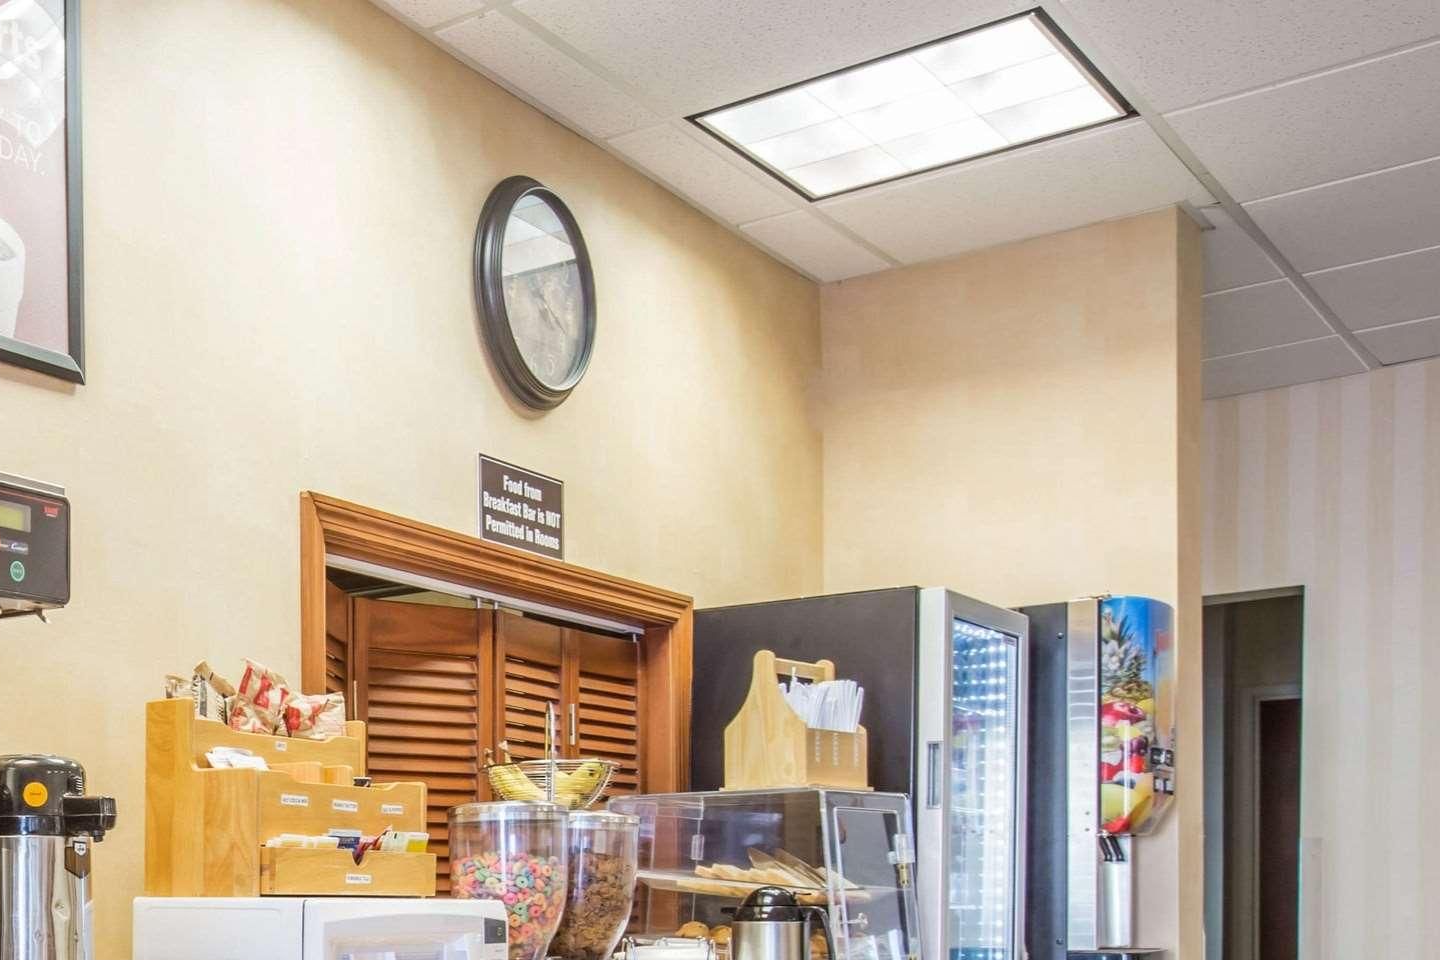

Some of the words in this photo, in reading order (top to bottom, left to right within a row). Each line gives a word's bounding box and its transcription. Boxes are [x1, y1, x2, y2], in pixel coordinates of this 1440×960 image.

[503, 475, 522, 496] Food
[524, 482, 542, 502] from
[484, 491, 522, 517] Breakfast
[523, 503, 536, 521] Bar
[538, 508, 544, 524] is
[546, 511, 560, 528] NOT
[486, 514, 524, 540] Permitted
[526, 526, 533, 542] in
[534, 528, 559, 550] Rooms
